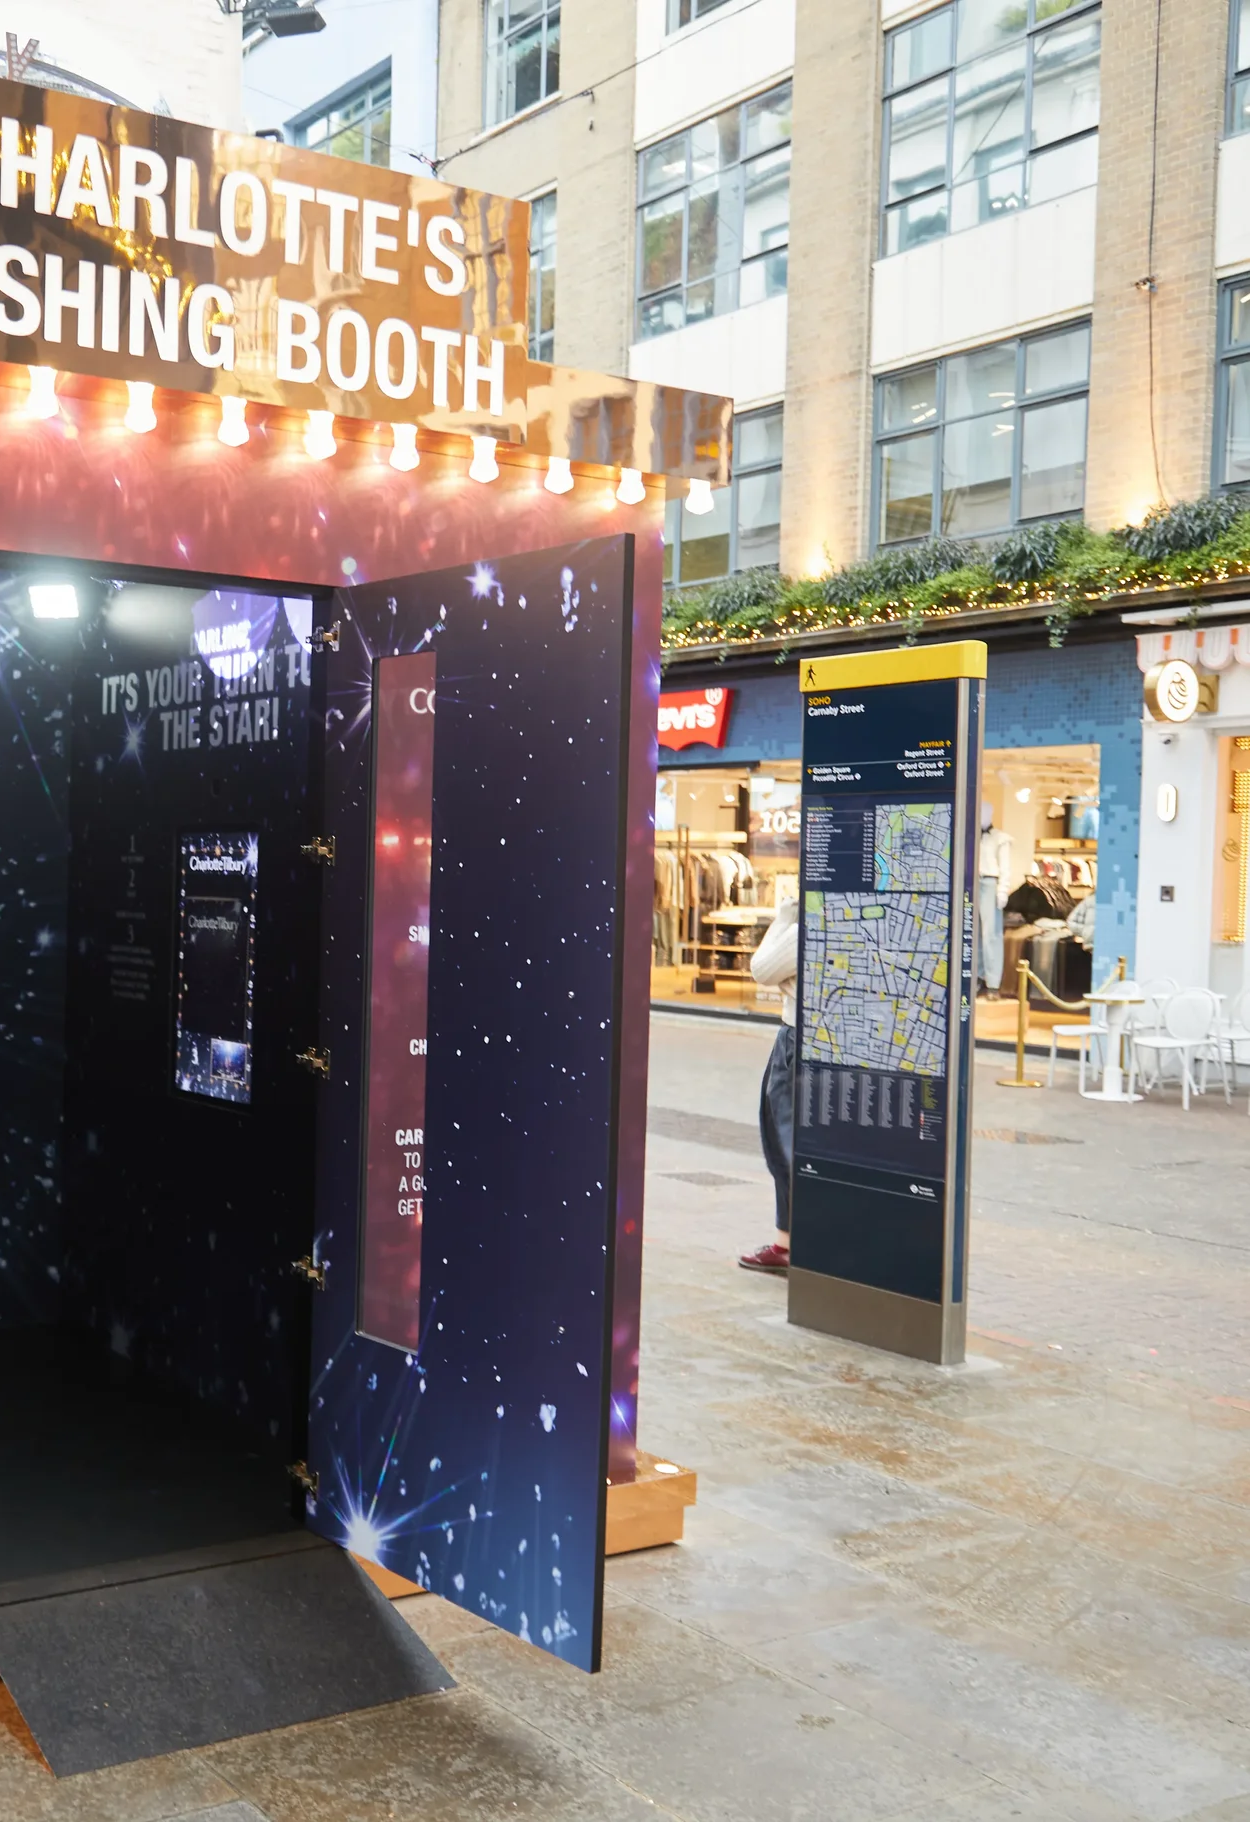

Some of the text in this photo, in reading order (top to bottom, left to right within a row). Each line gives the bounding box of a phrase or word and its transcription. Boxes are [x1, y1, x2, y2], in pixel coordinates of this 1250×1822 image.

[276, 300, 505, 417] BOOTH
[102, 672, 139, 715] IT'S
[146, 662, 202, 708] YOUR
[210, 647, 276, 699] TURN
[808, 696, 831, 706] SOHO
[808, 704, 865, 717] Carnaby Street
[160, 697, 280, 751] THE STAR!
[925, 769, 944, 777] Street
[395, 1128, 423, 1146] CAR
[403, 1152, 421, 1168] TO
[398, 1176, 409, 1192] A
